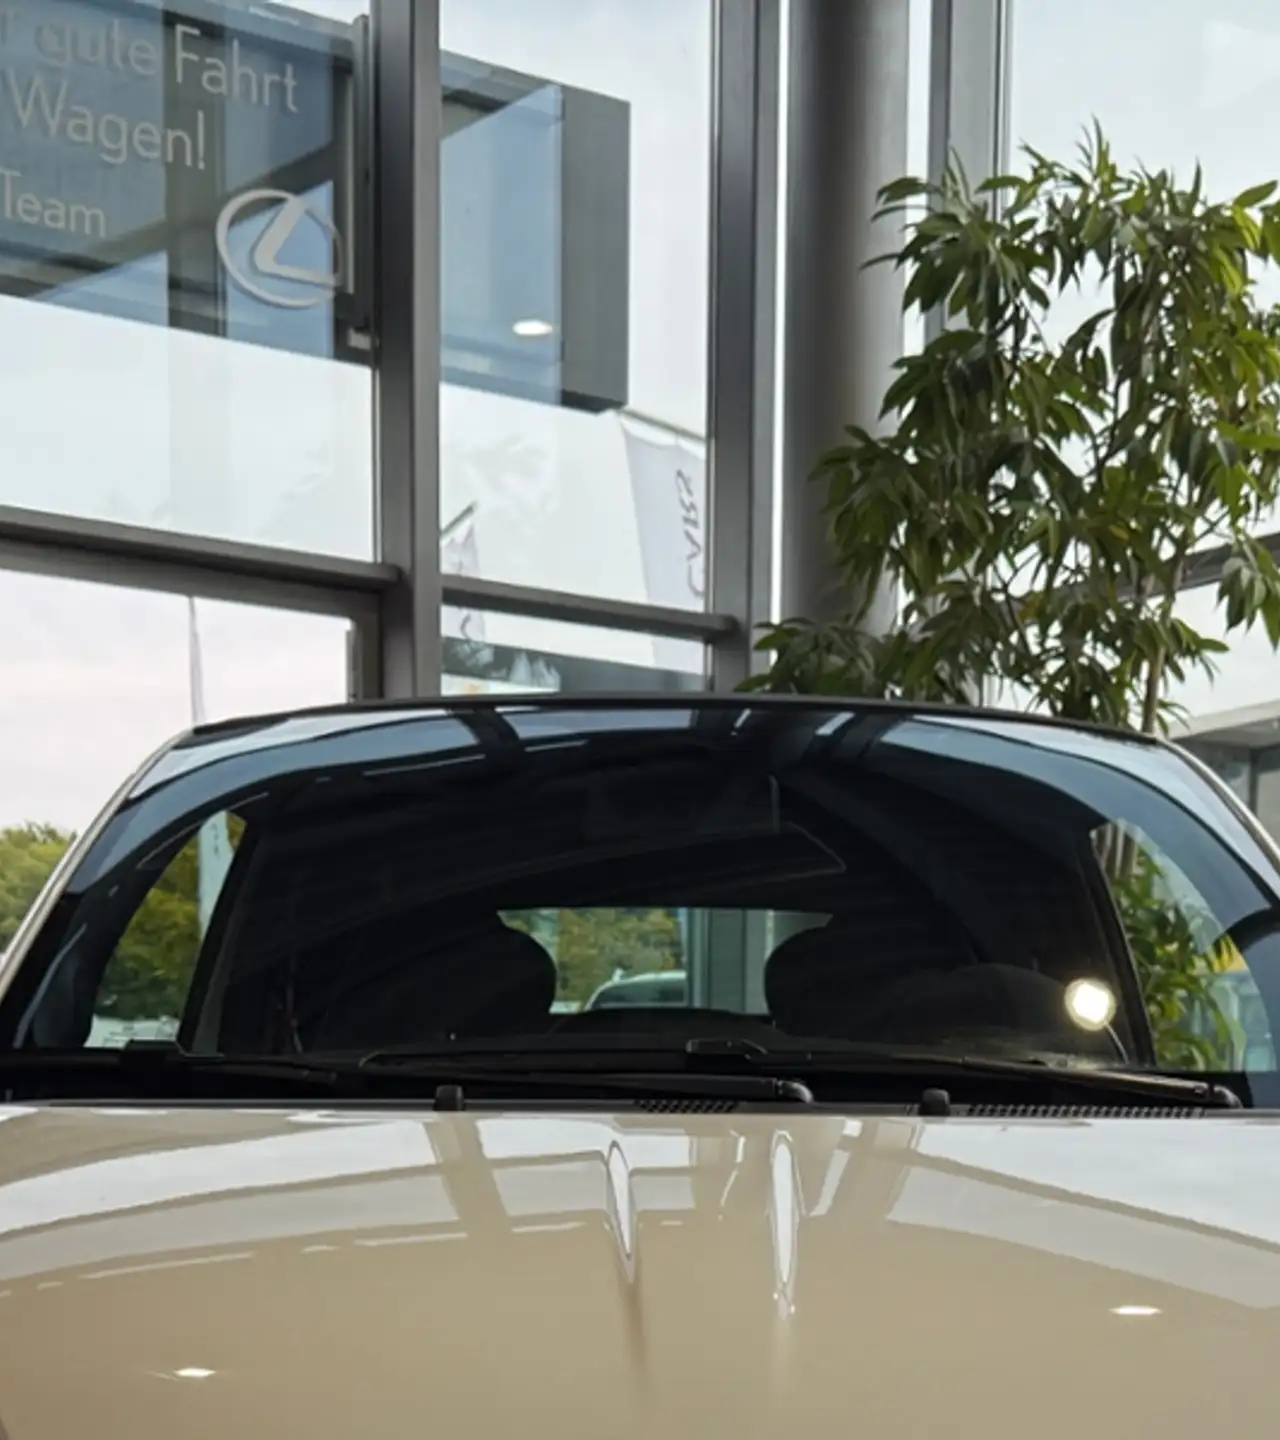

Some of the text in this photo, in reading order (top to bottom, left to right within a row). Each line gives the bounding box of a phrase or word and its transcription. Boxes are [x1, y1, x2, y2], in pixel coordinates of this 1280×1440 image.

[36, 19, 159, 76] gute
[173, 24, 299, 113] Fahrt
[1, 67, 206, 171] Wagen!
